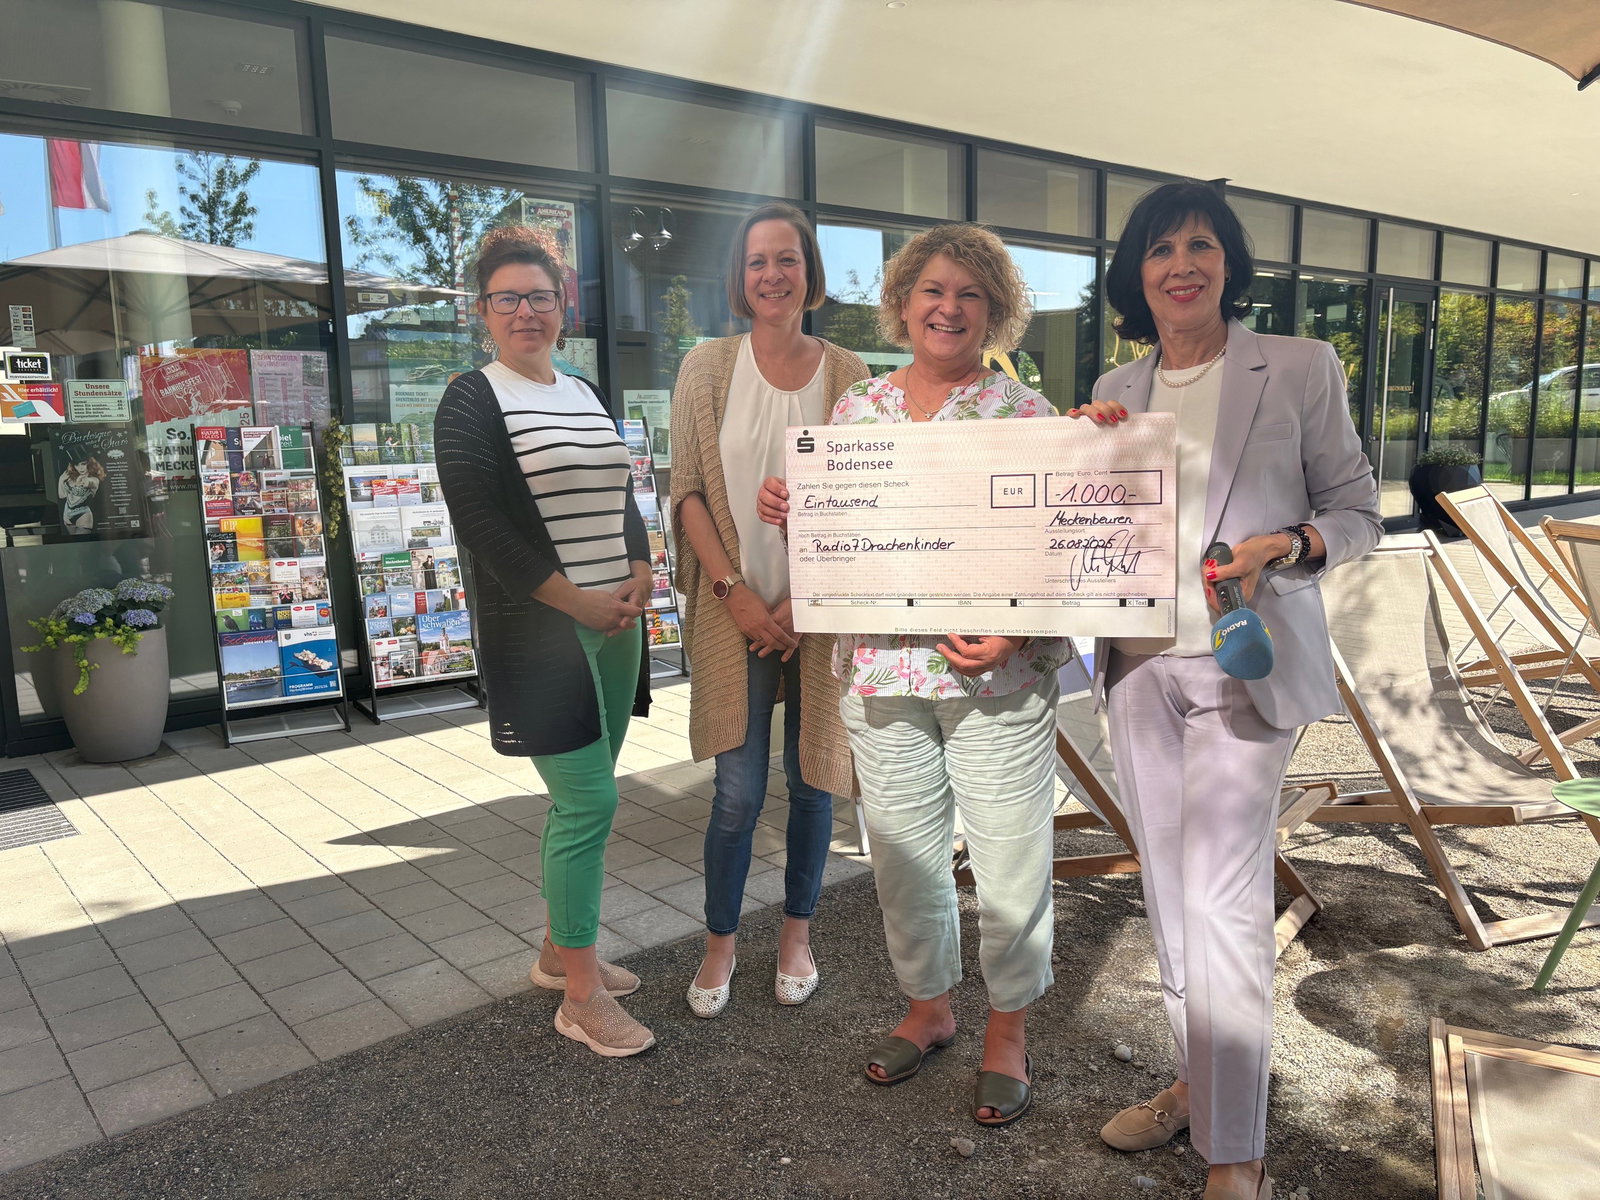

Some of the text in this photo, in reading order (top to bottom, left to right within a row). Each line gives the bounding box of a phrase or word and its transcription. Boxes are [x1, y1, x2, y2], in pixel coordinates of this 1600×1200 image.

[16, 358, 42, 369] ticket
[166, 428, 192, 441] So.
[827, 440, 895, 455] Sparkasse
[827, 458, 893, 471] Bodensee
[822, 482, 834, 490] Sie
[884, 480, 910, 488] Scheck
[1003, 487, 1024, 495] EUR
[804, 495, 879, 509] Eintausend
[1049, 510, 1133, 527] Meckenbeuren
[816, 554, 856, 564] Überbringer
[422, 619, 461, 629] schwaben
[1223, 619, 1247, 636] RADIO
